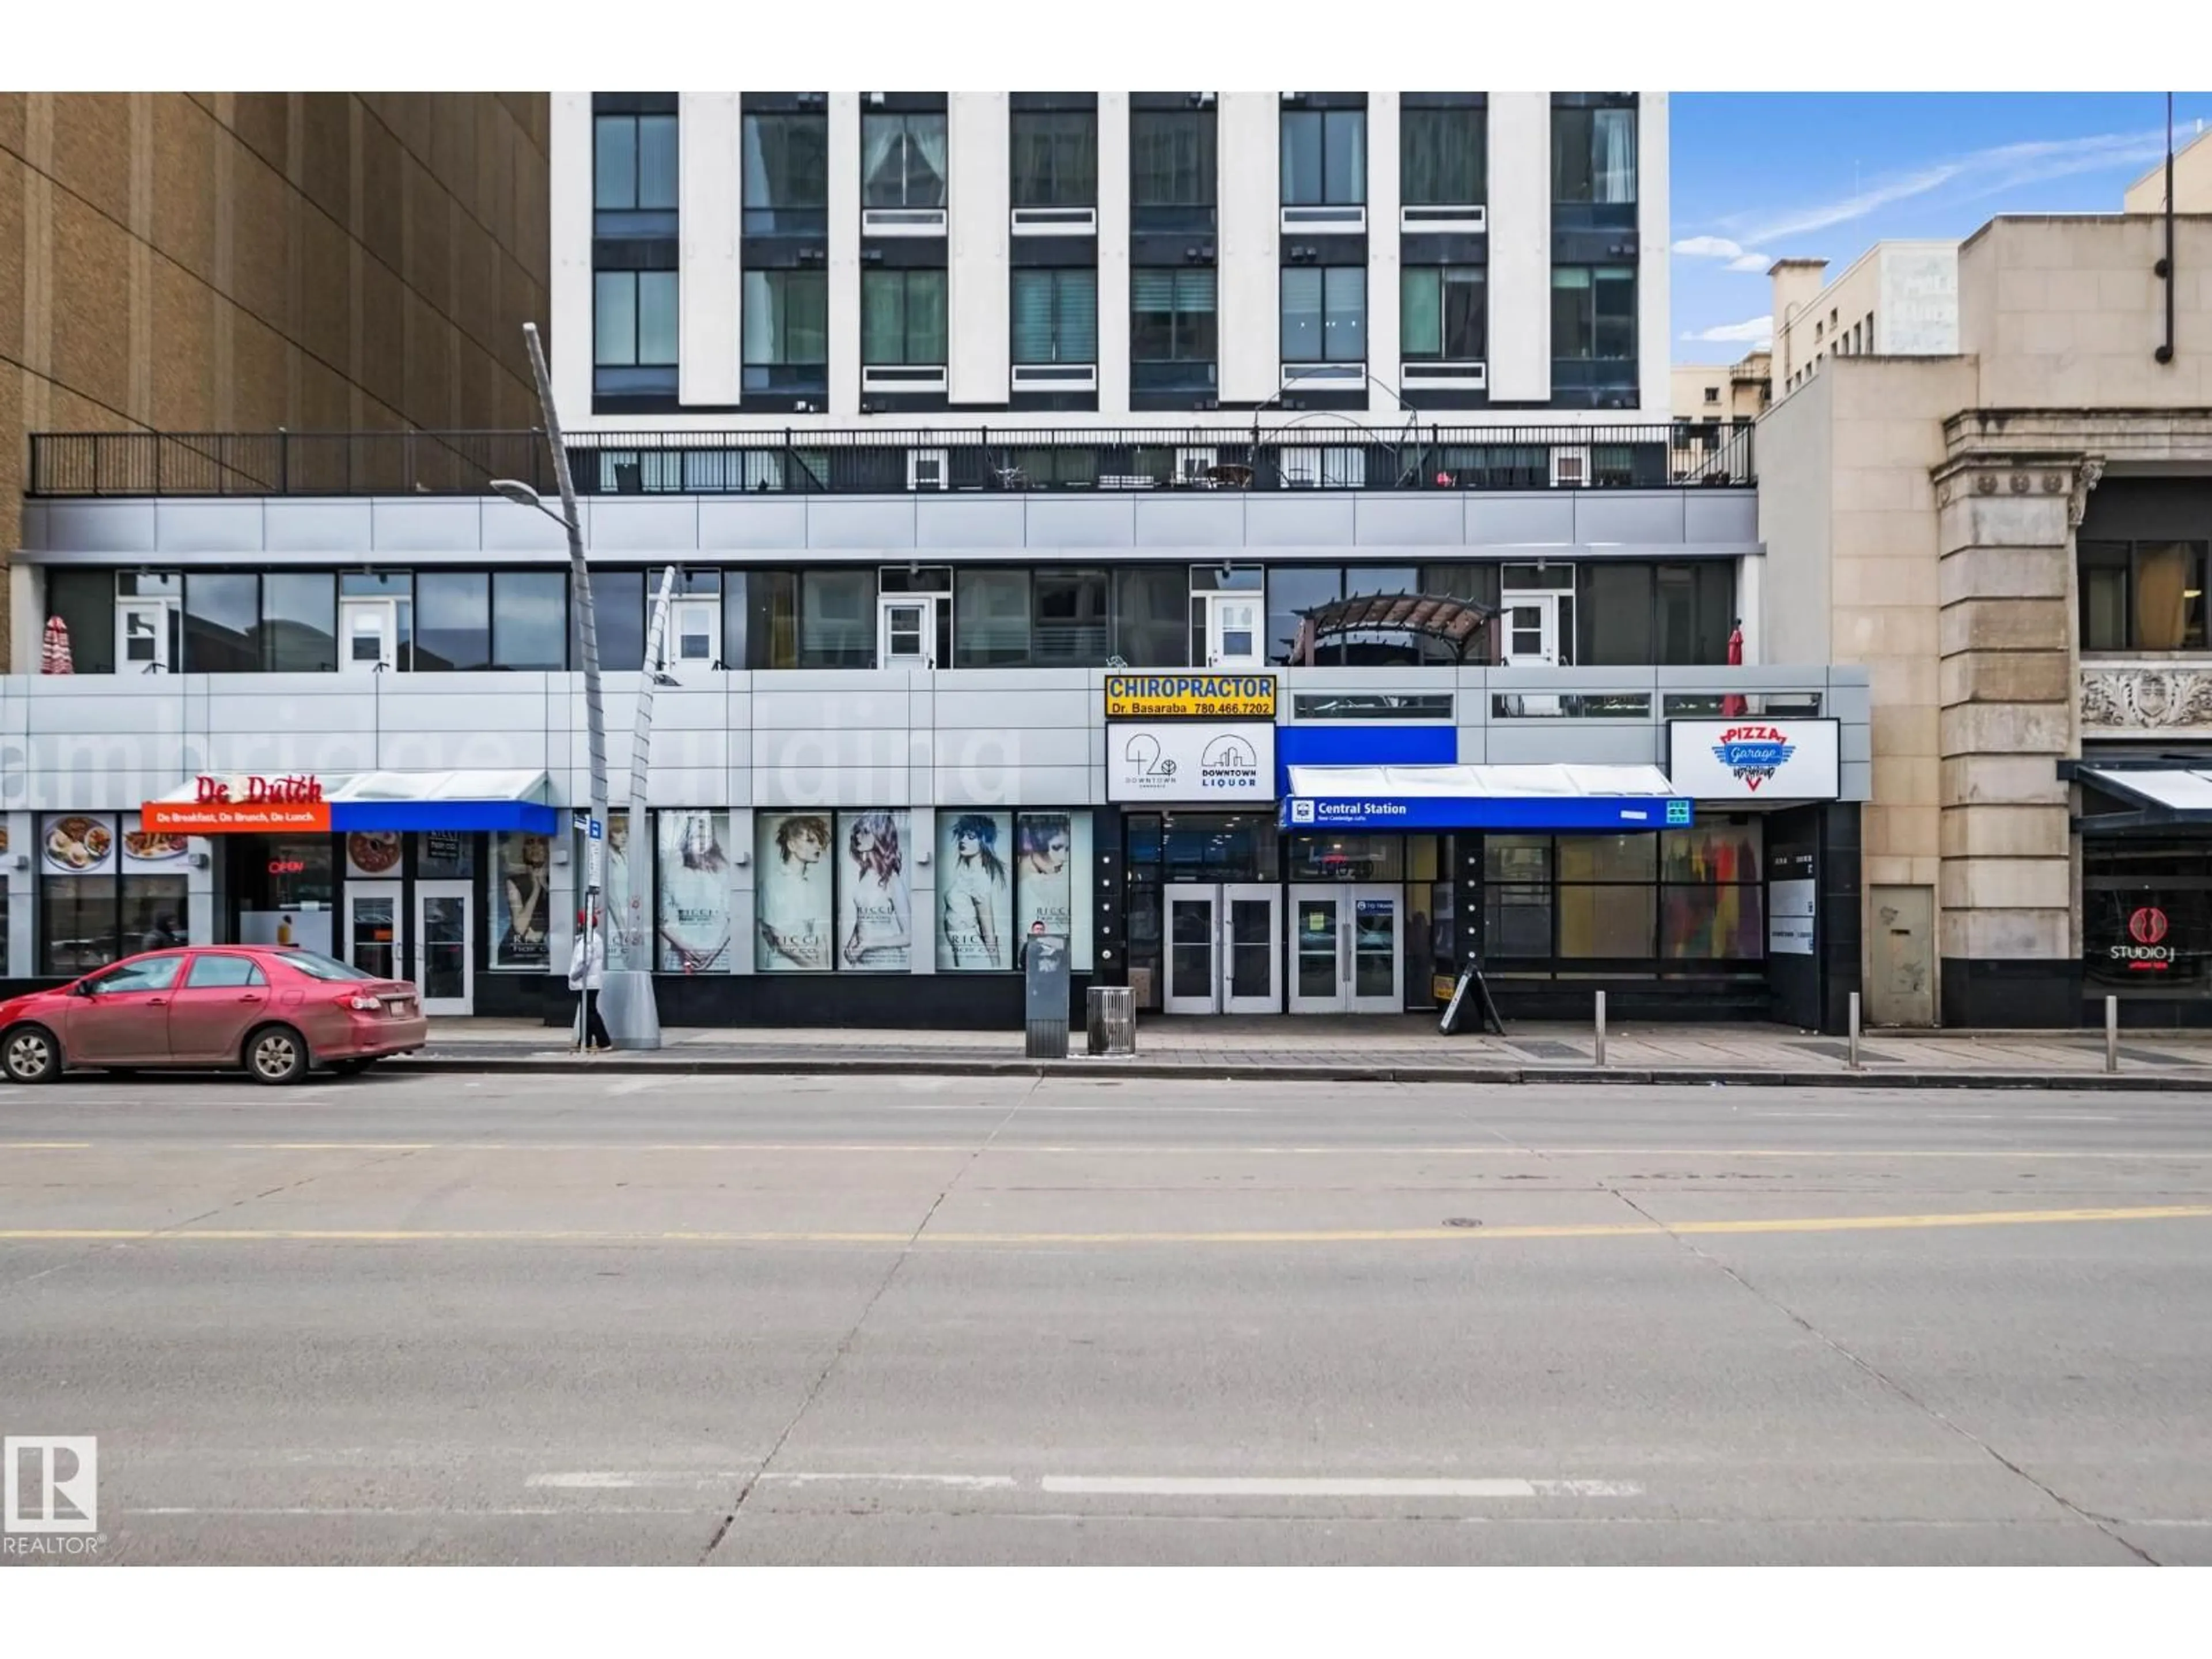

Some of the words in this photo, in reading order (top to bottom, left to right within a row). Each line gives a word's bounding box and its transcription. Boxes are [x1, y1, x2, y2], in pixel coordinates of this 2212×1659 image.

[1109, 678, 1272, 698] CHIROPRACTOR
[1112, 704, 1127, 713] Dr.
[1132, 703, 1187, 713] Basaraba
[1195, 703, 1270, 714] 780.466.7202
[1726, 727, 1779, 741] PIZZA
[1730, 747, 1777, 763] Garage
[1202, 769, 1257, 777] DOWNTOWN
[195, 775, 230, 804] De
[248, 775, 321, 804] Dutch
[1202, 779, 1256, 787] LIQUOR
[1318, 802, 1361, 814] Central
[1364, 802, 1407, 815] Station
[952, 935, 998, 944] RICI
[2110, 945, 2167, 959] STUDIO
